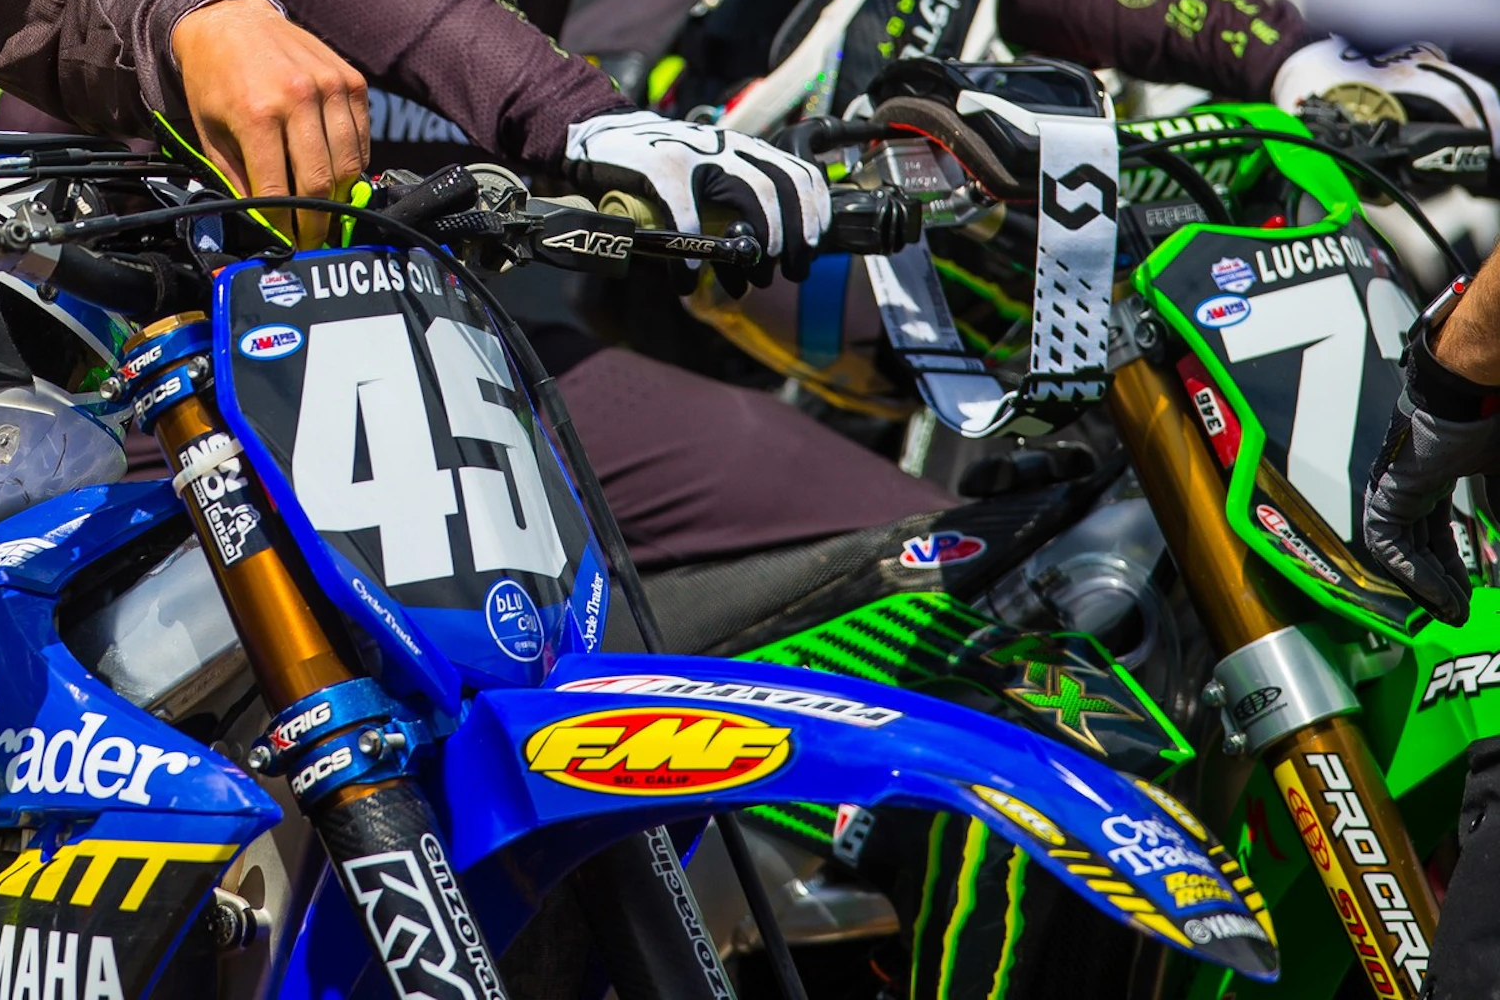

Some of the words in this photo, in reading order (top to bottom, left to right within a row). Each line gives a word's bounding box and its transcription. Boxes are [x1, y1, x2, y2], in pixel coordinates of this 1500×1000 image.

[542, 229, 633, 259] ARC
[665, 236, 715, 252] ARC
[1256, 236, 1346, 284] LUCAS
[1340, 235, 1372, 268] OIL
[310, 258, 405, 299] LUCAS
[406, 260, 443, 296] OIL
[118, 345, 162, 382] XTRIG
[249, 335, 281, 352] AMA
[292, 312, 568, 587] 45
[211, 508, 236, 559] enzo
[350, 577, 385, 616] Cycle
[382, 607, 422, 655] Trader
[587, 573, 606, 616] Trader
[268, 701, 332, 751] XTRIG
[529, 717, 791, 771] FMF
[291, 746, 352, 796] ROCS
[613, 775, 639, 786] SO.
[645, 775, 697, 786] CALIF.
[1306, 752, 1388, 866] PRO
